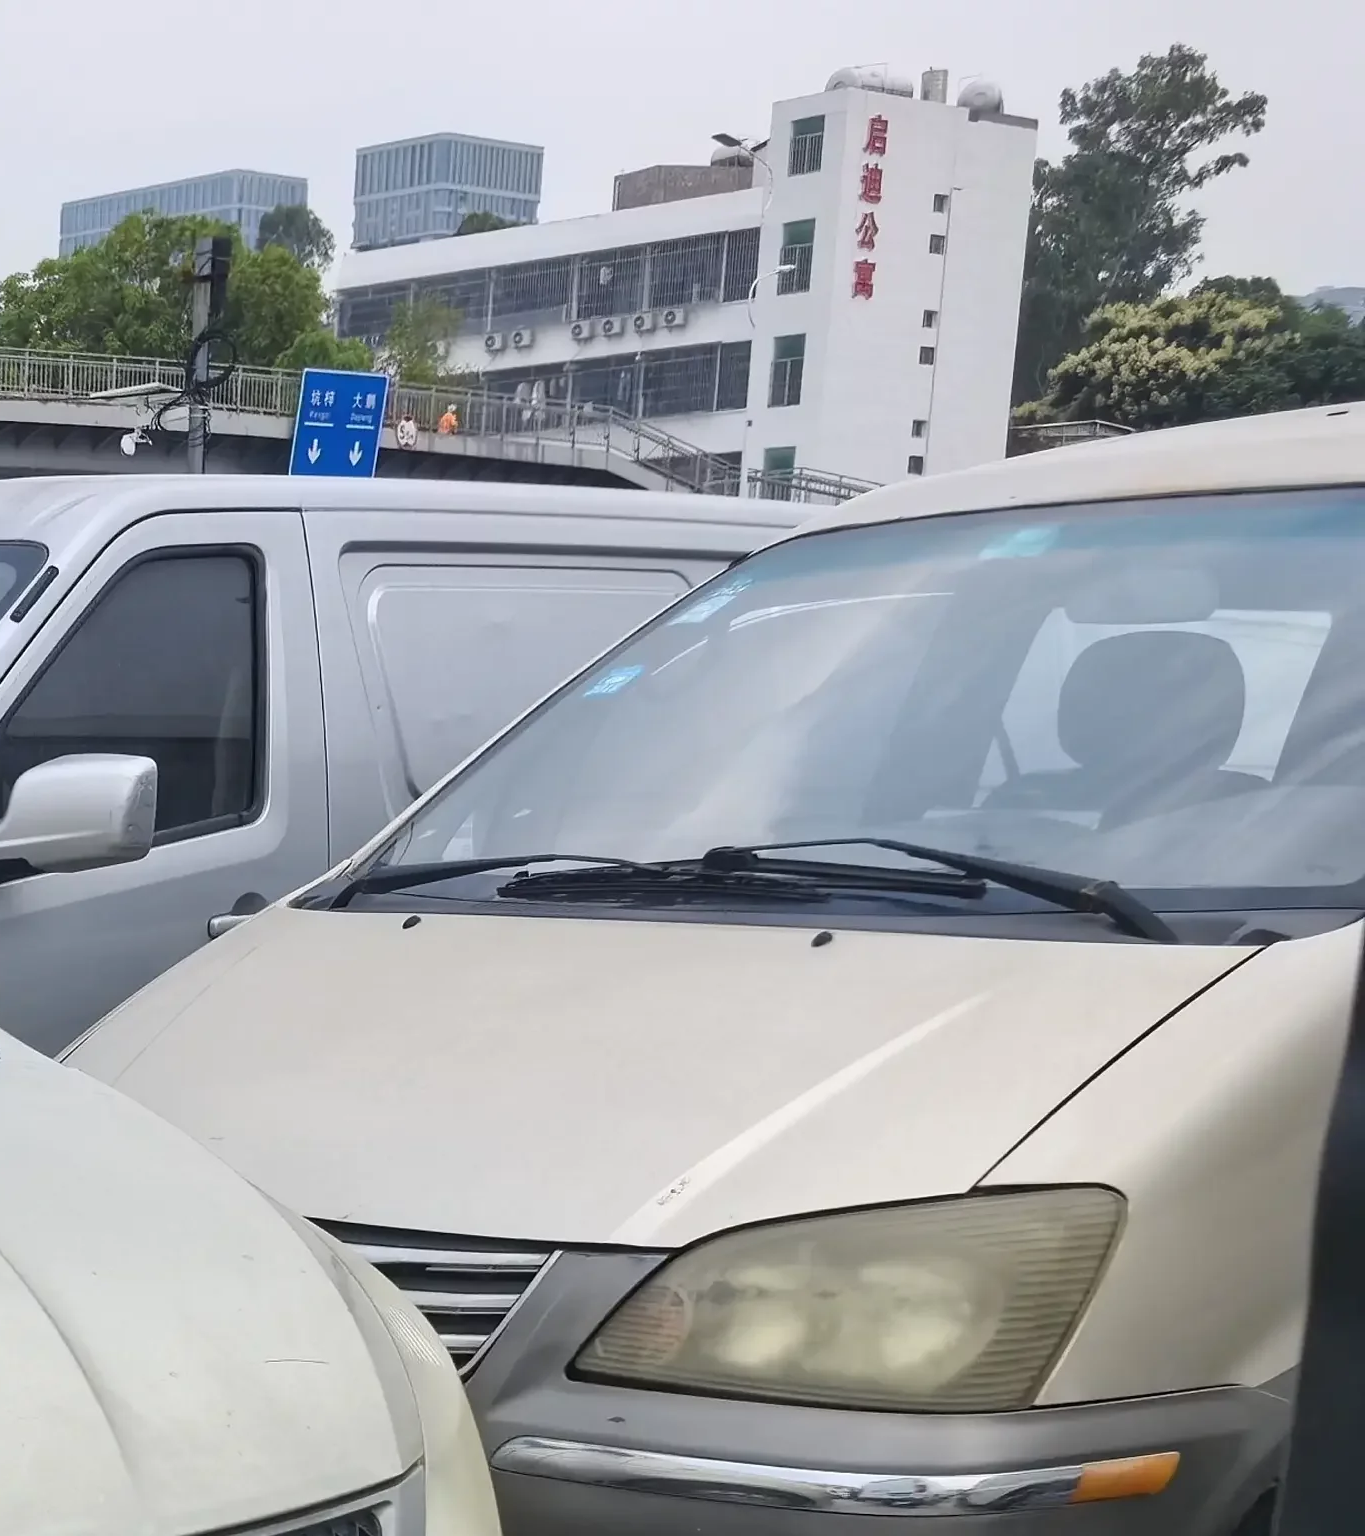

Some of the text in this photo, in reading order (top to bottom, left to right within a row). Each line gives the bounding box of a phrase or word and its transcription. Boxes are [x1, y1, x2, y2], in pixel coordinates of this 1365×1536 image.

[852, 114, 889, 301] 启迪公寓
[310, 389, 336, 408] 坑梓
[352, 391, 377, 410] 大鹏
